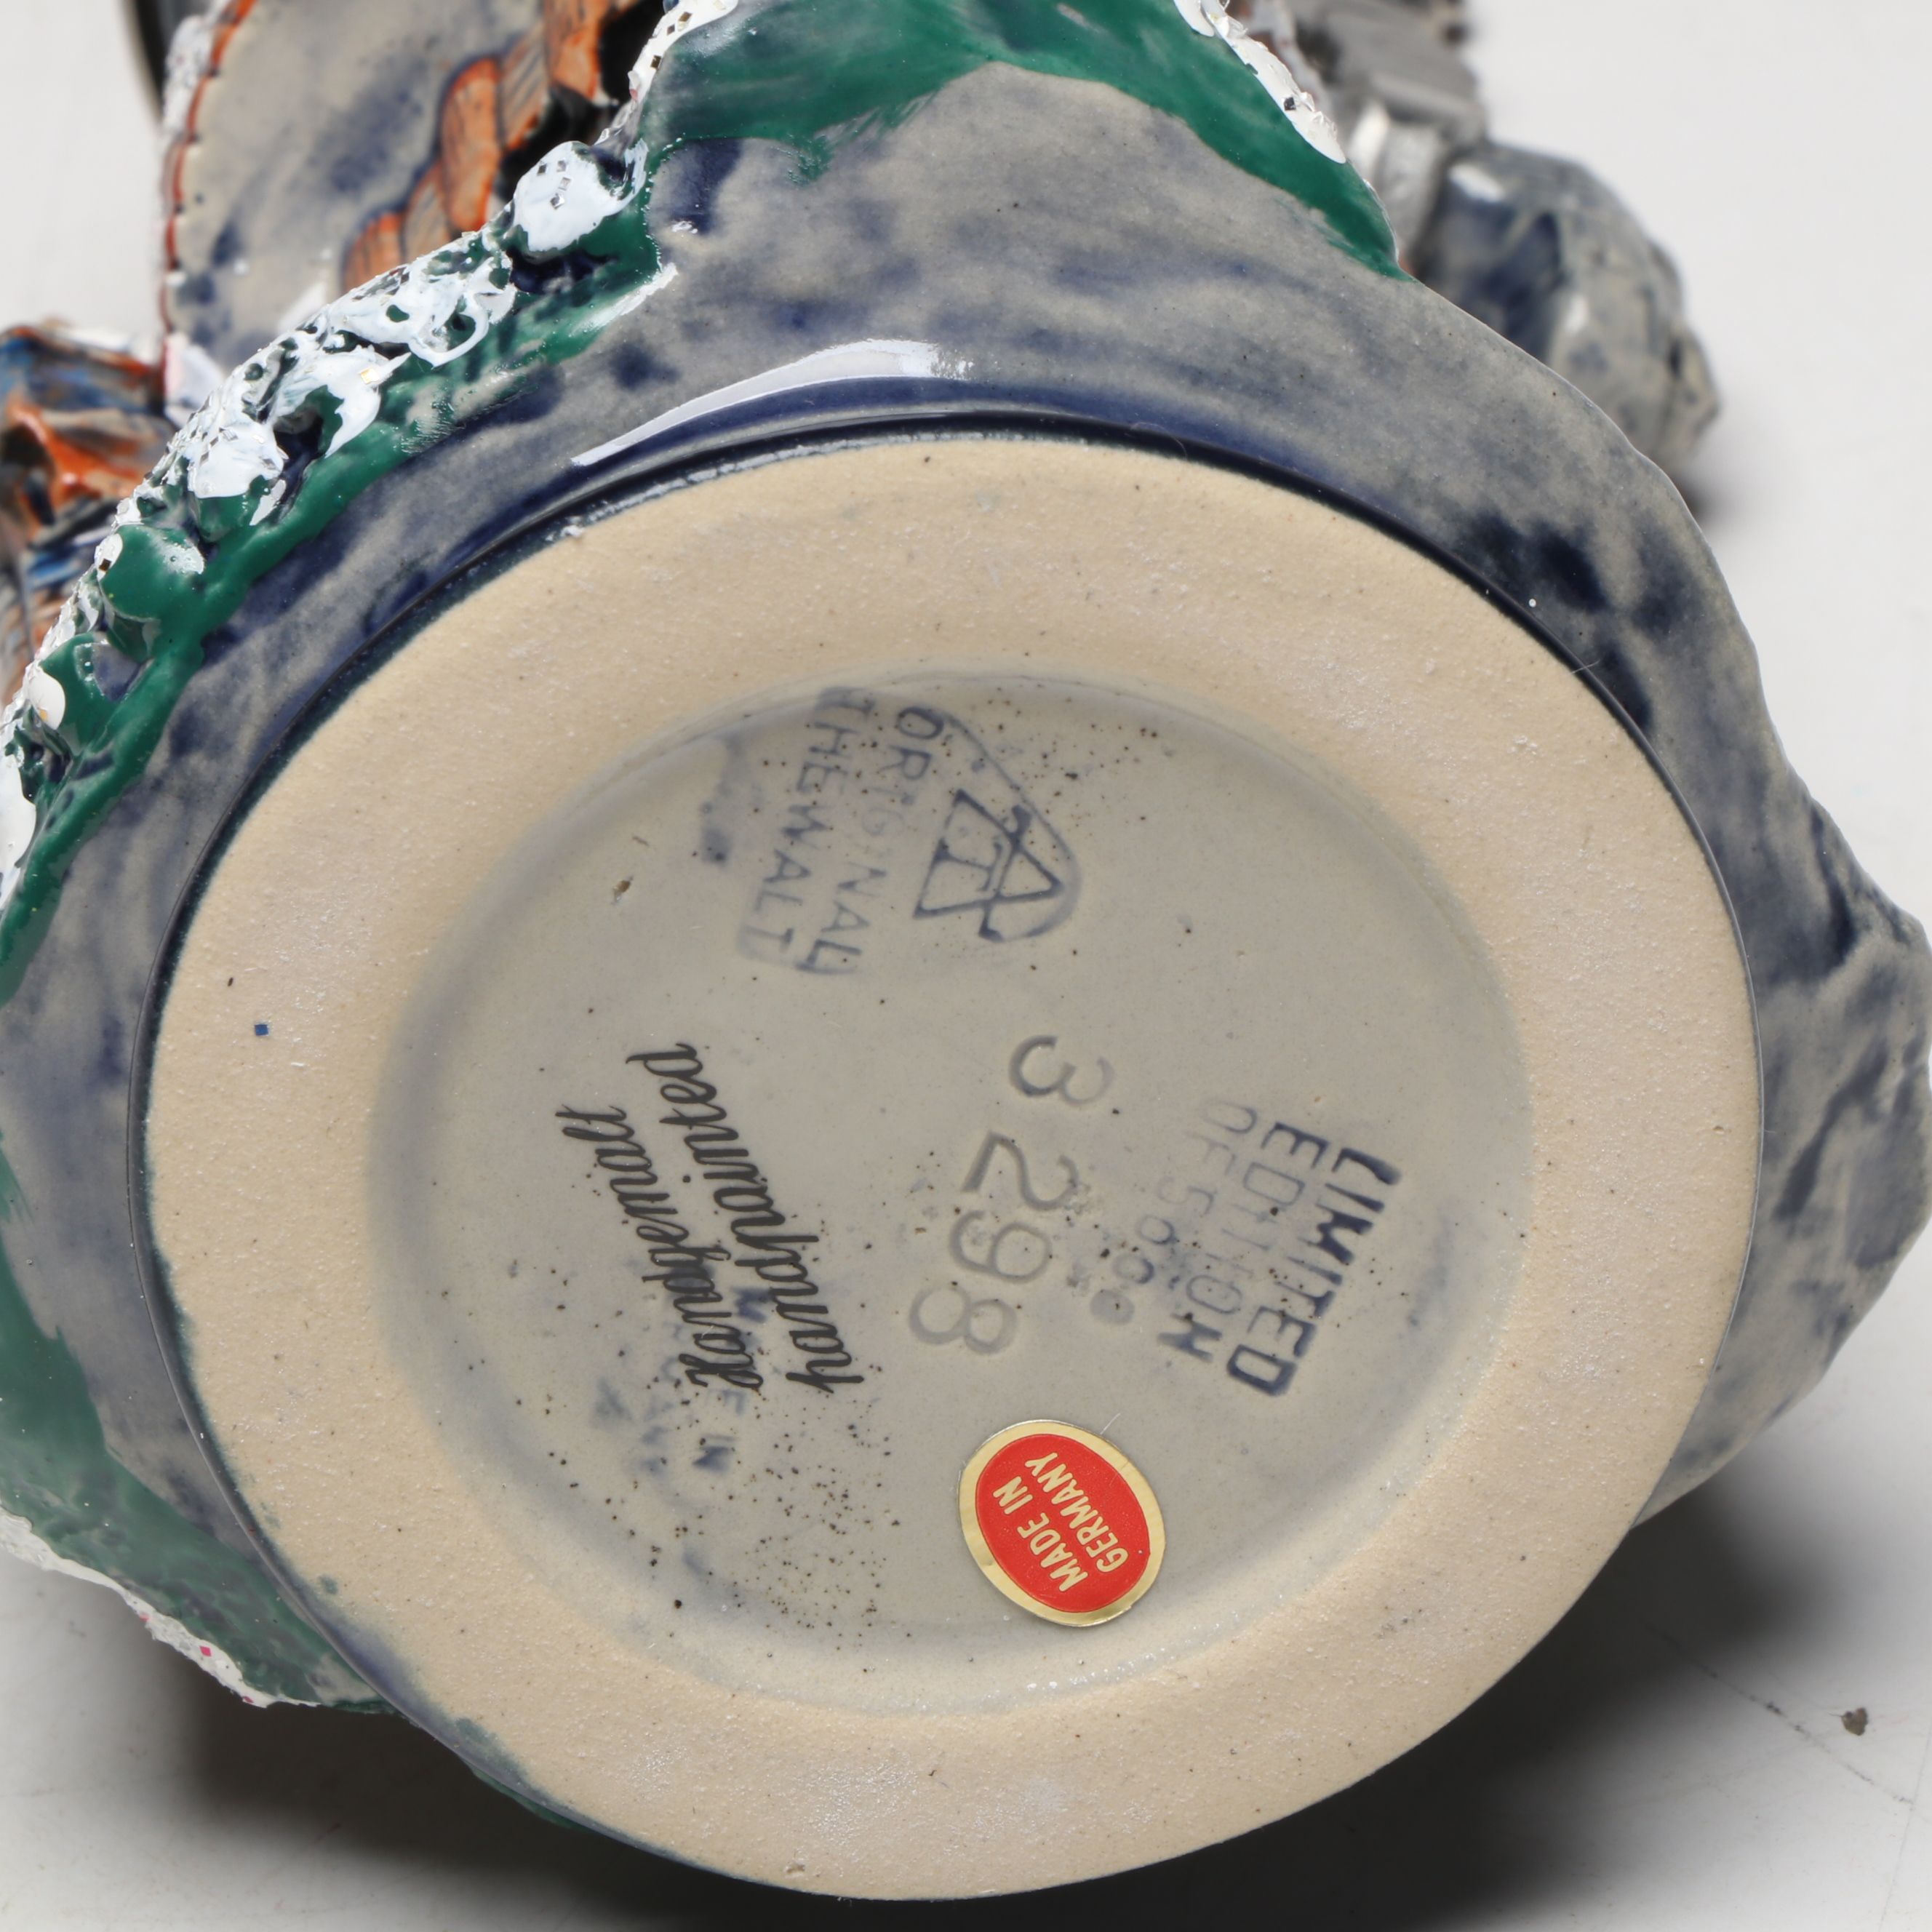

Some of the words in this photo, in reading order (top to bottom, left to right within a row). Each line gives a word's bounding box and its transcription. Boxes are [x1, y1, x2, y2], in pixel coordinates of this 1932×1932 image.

[743, 690, 875, 953] THEWALT
[799, 706, 944, 972] ORIGNAL
[555, 1104, 763, 1388] Handgemalt
[626, 1043, 864, 1394] handpainted
[1186, 1097, 1258, 1176] OF
[1226, 1148, 1402, 1397] LIMITED
[992, 1476, 1034, 1515] IN
[1017, 1512, 1088, 1592] MADE
[1024, 1452, 1129, 1573] GERMANY
